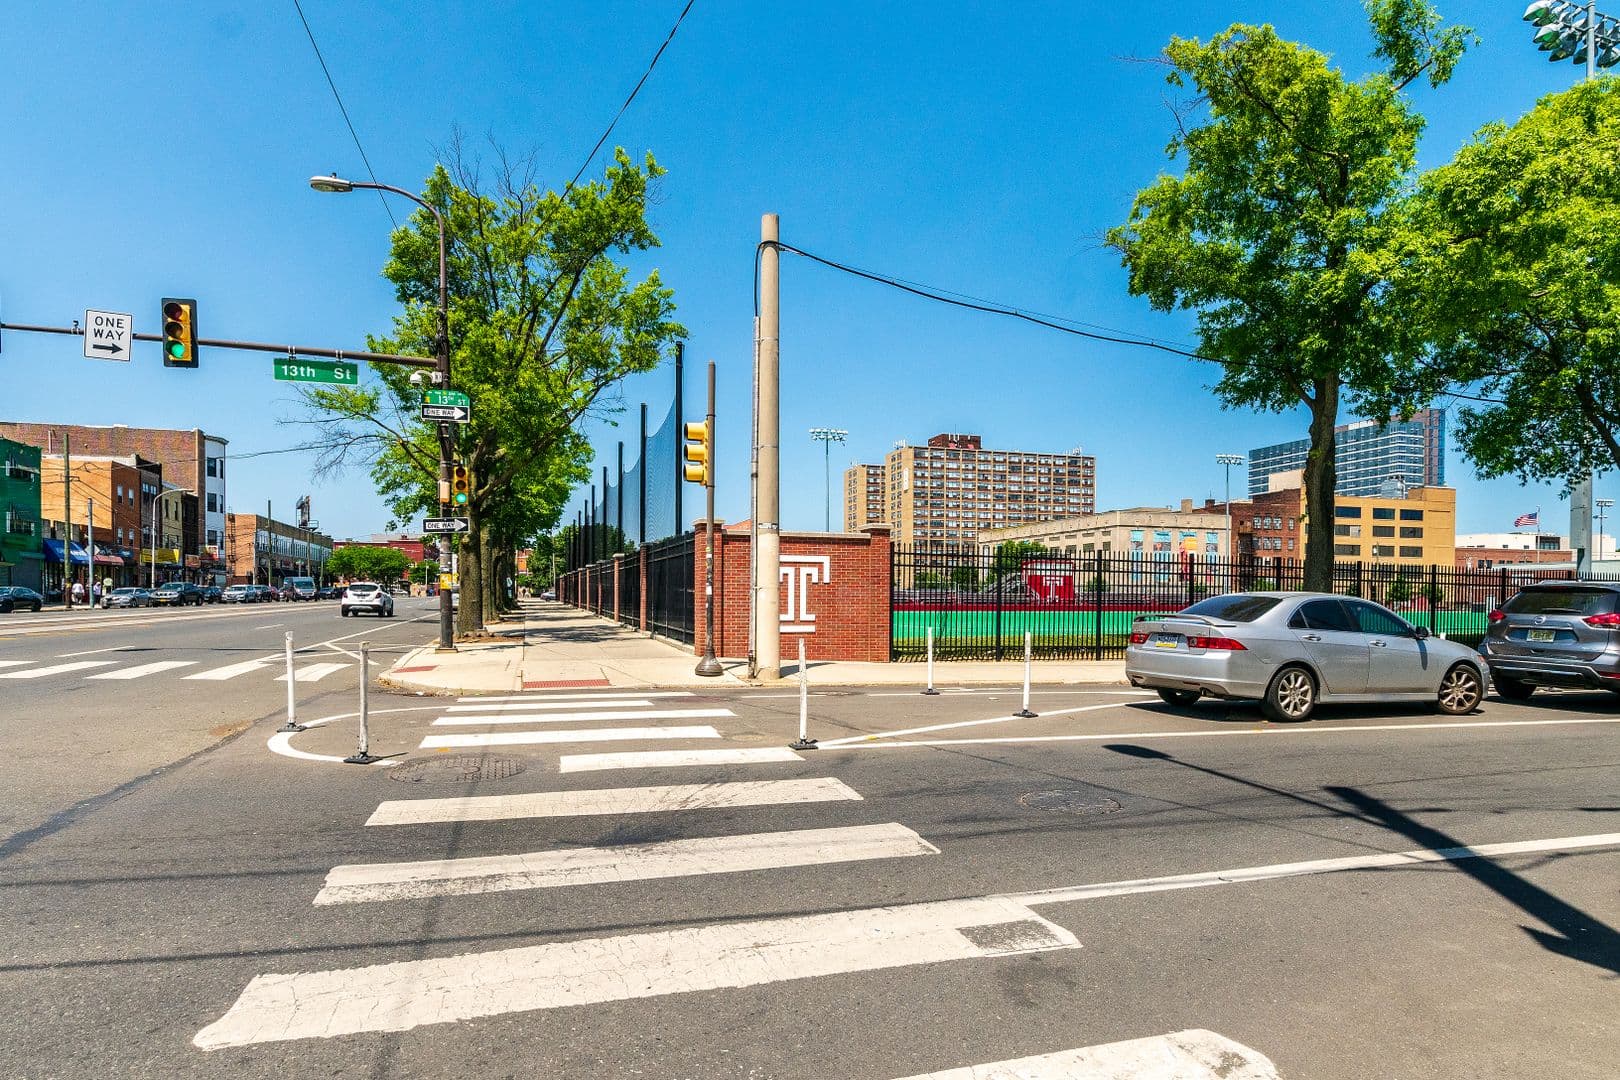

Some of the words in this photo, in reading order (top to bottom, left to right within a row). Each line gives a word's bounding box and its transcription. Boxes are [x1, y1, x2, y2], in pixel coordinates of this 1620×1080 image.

[94, 315, 125, 329] ONE
[93, 328, 125, 341] WAY
[281, 365, 316, 378] 13th
[333, 367, 352, 380] St
[426, 408, 441, 416] ONE
[442, 409, 454, 418] WAY
